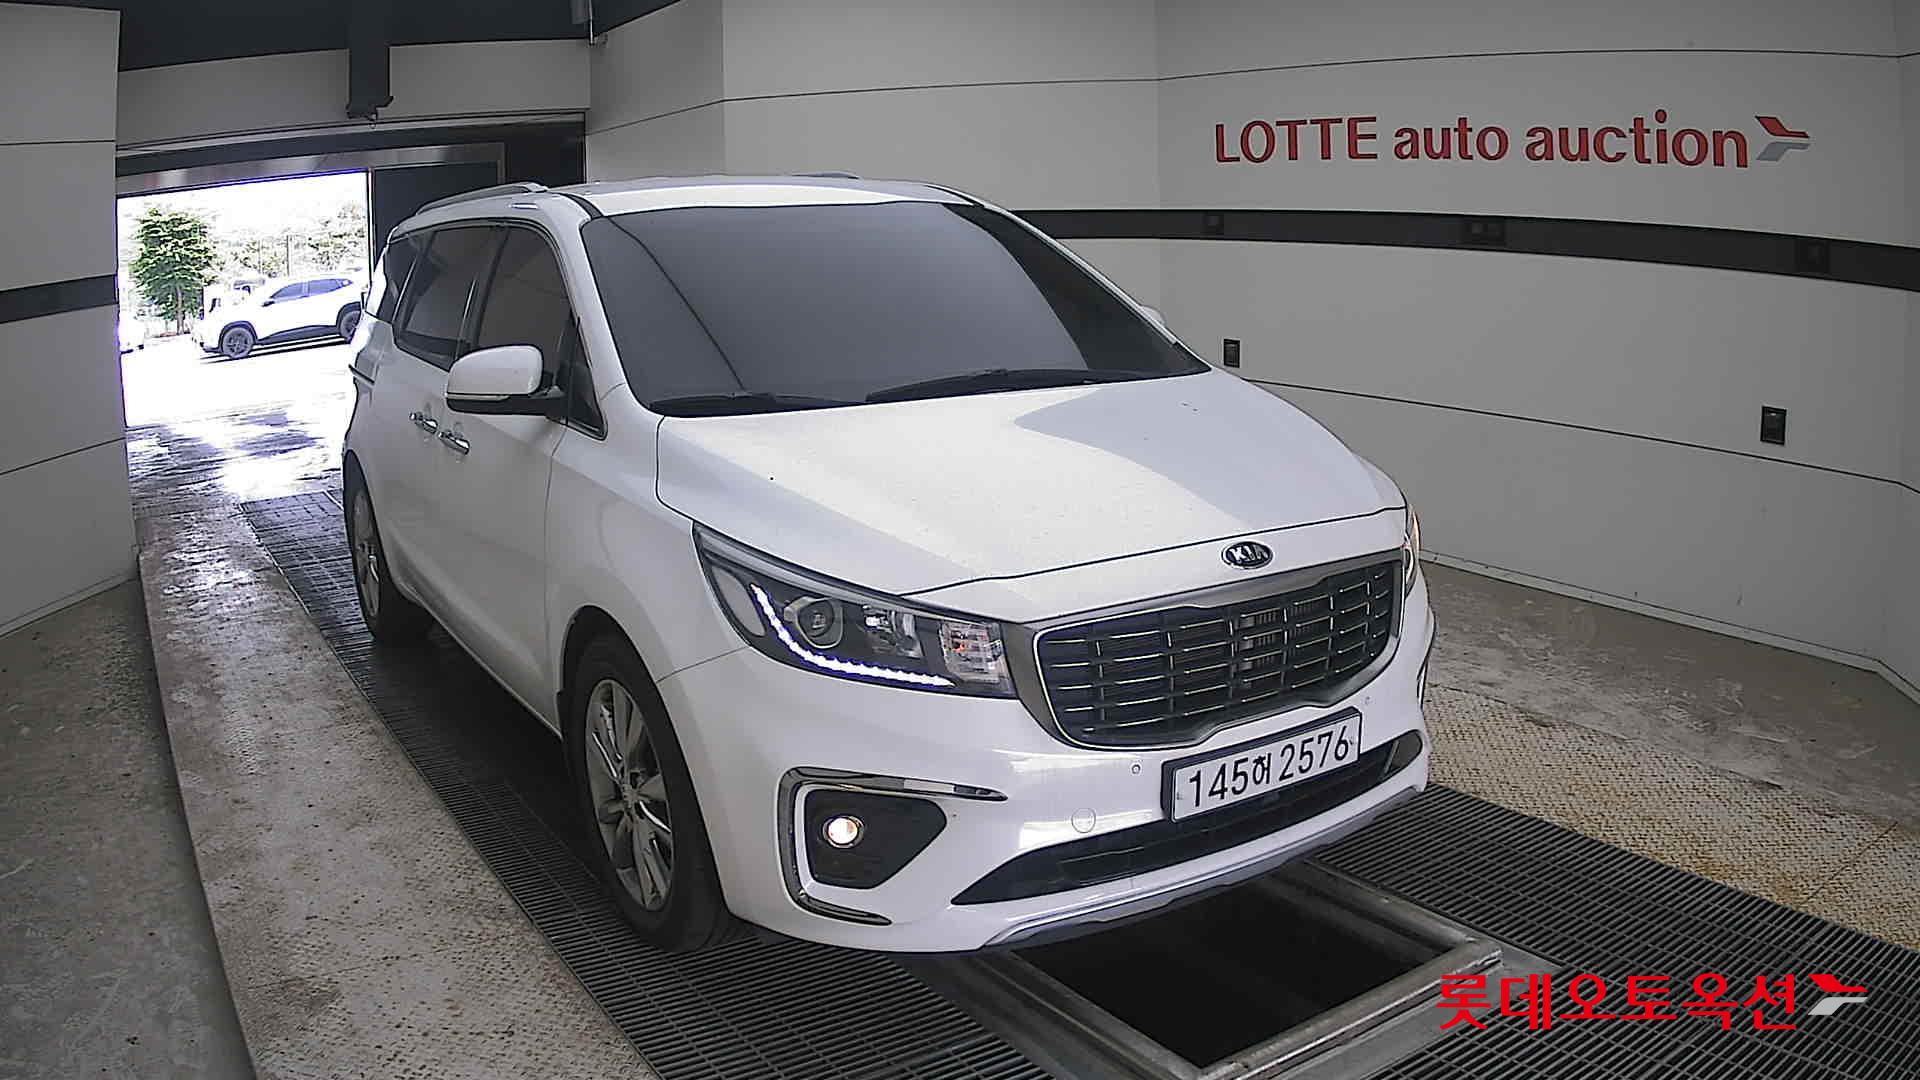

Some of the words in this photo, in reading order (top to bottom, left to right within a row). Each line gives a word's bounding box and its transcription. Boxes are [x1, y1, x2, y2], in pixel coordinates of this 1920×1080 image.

[1214, 116, 1377, 163] LOTTE
[1393, 116, 1510, 162] auto
[1524, 108, 1749, 169] auction
[1228, 544, 1269, 562] KIA
[1188, 752, 1272, 808] 145허
[1278, 725, 1349, 782] 2576
